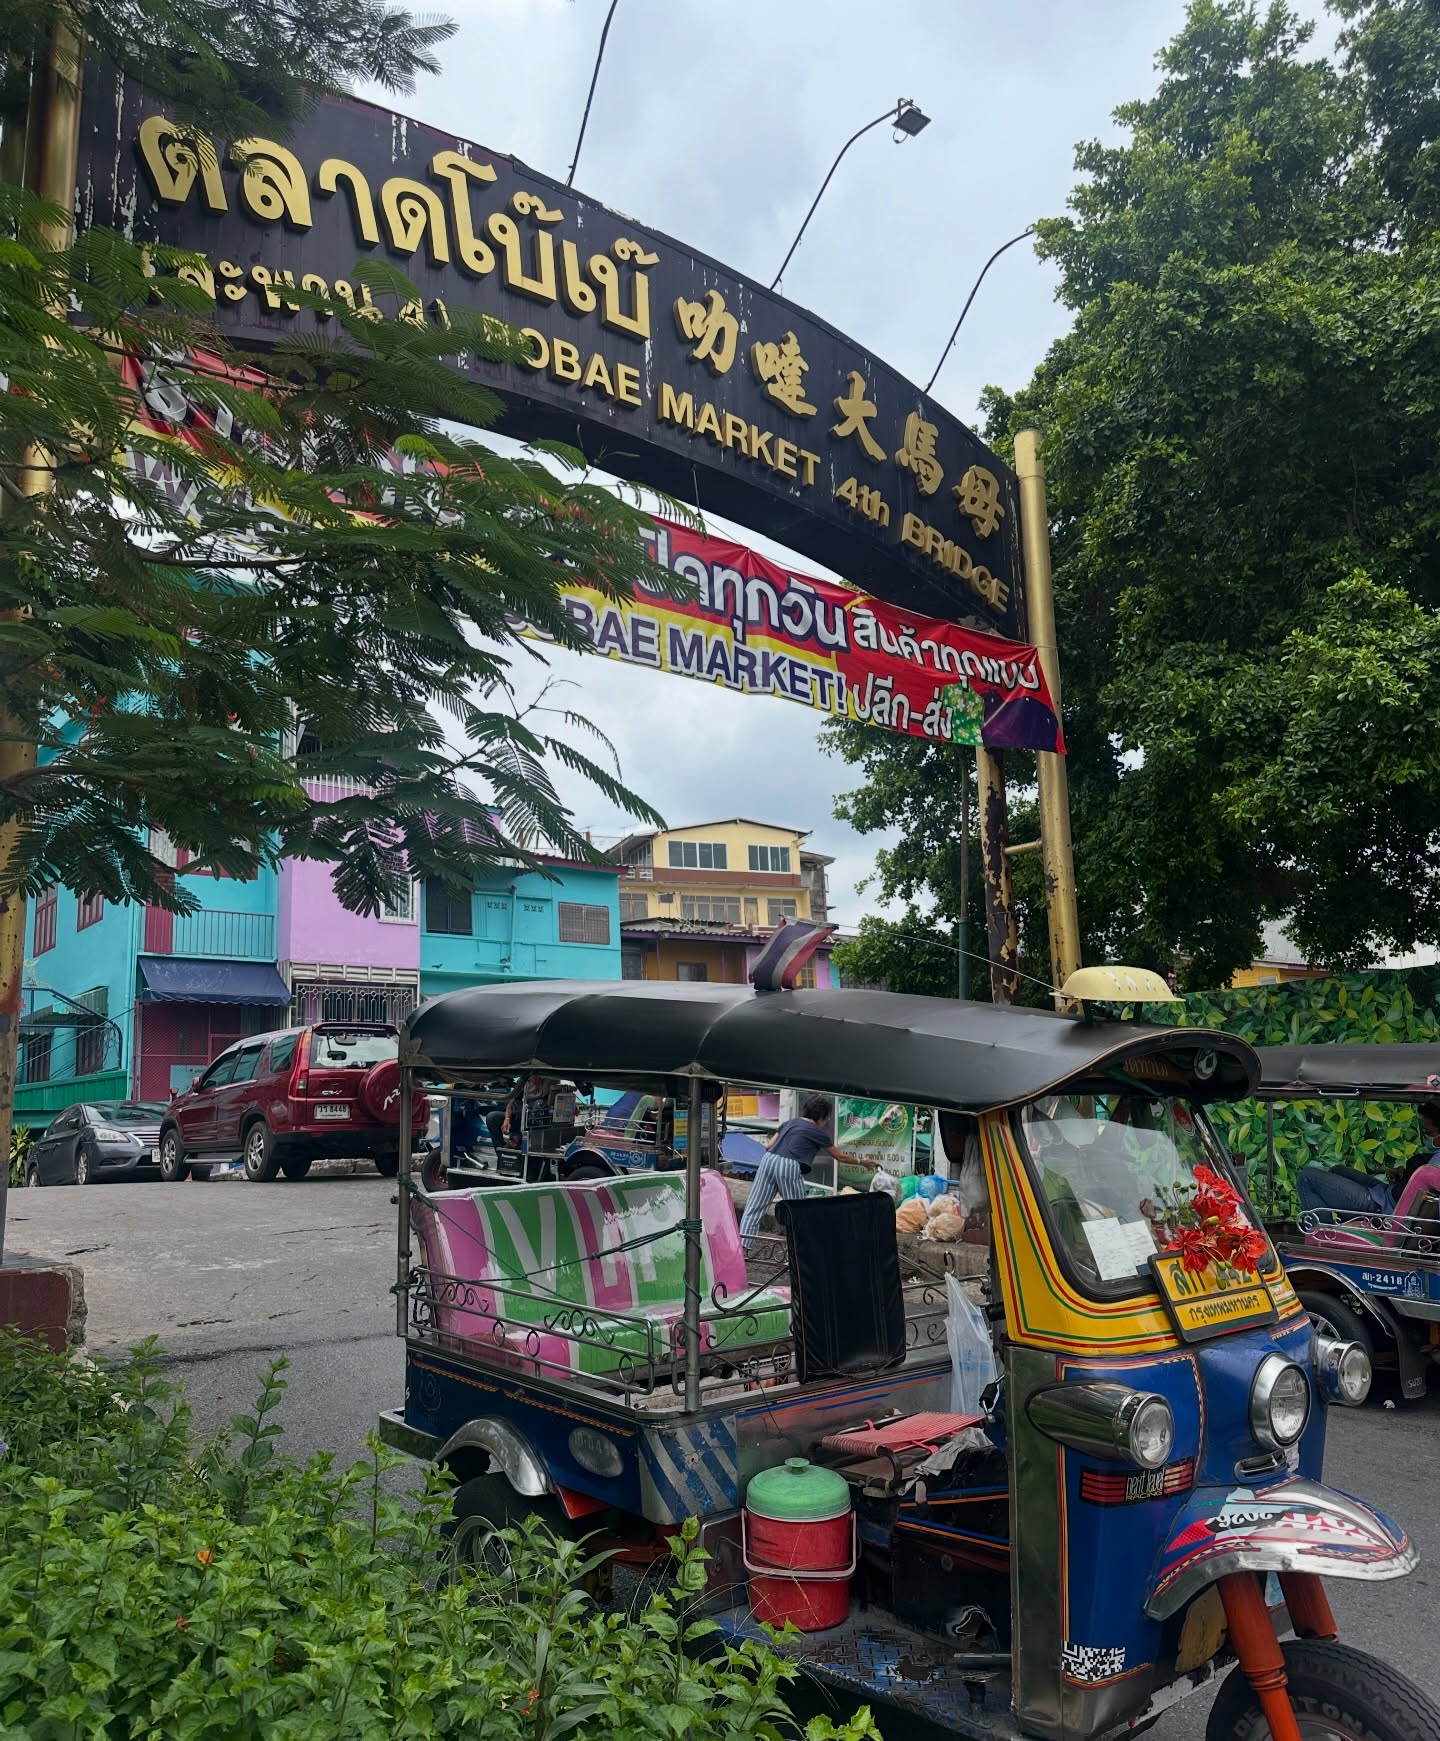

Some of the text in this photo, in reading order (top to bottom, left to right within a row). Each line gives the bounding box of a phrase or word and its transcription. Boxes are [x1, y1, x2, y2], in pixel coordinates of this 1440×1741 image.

[138, 115, 660, 341] ตลาดโบ๊เบ๊
[658, 382, 821, 487] MARKET
[836, 476, 891, 528] 4th
[902, 512, 1011, 614] BRIDGE
[668, 624, 847, 715] MARKET!
[850, 606, 1041, 691] สินค้าทุกแบบ
[852, 672, 954, 740] ปลีก-ส่ง
[1188, 1295, 1260, 1324] กรุงเทพมหานคร
